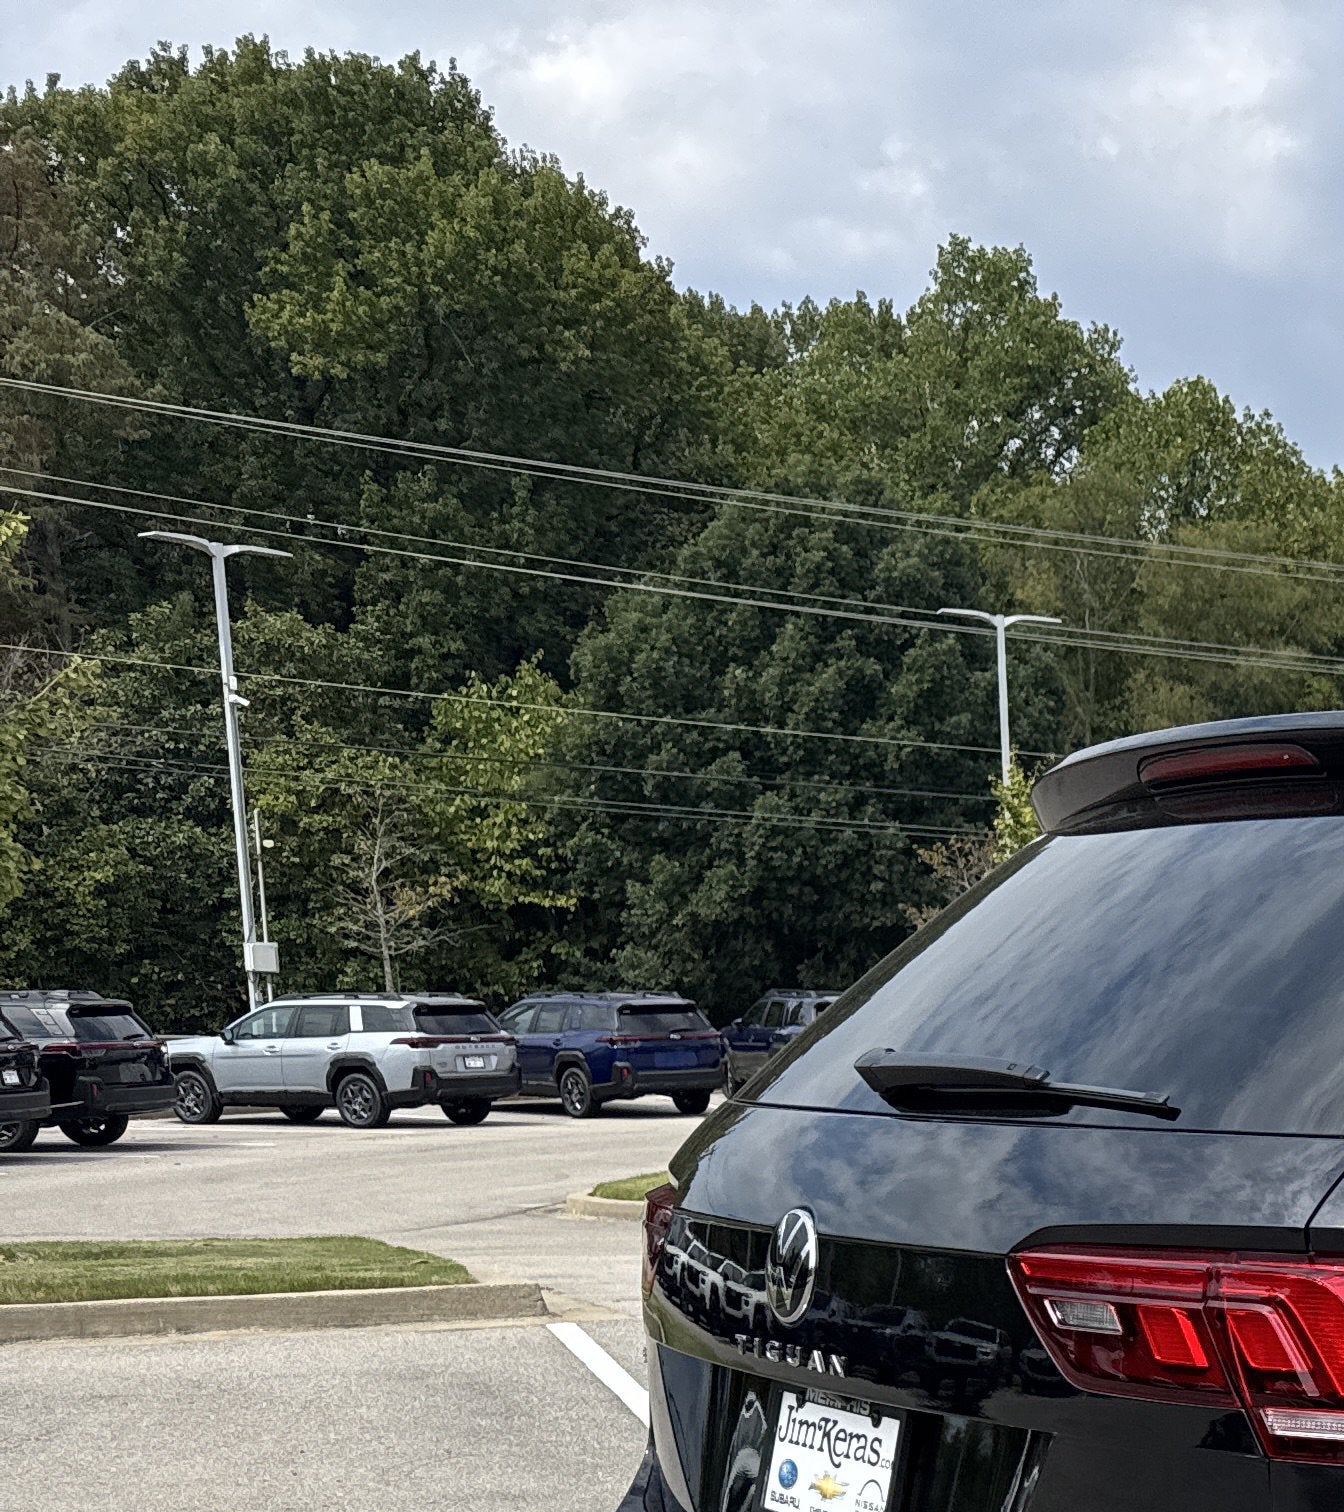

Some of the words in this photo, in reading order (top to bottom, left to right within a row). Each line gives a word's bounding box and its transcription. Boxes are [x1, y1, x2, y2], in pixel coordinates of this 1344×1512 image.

[734, 1333, 847, 1379] TIGUAN
[777, 1404, 893, 1470] JimKeras.co
[770, 1490, 801, 1510] SUBARU
